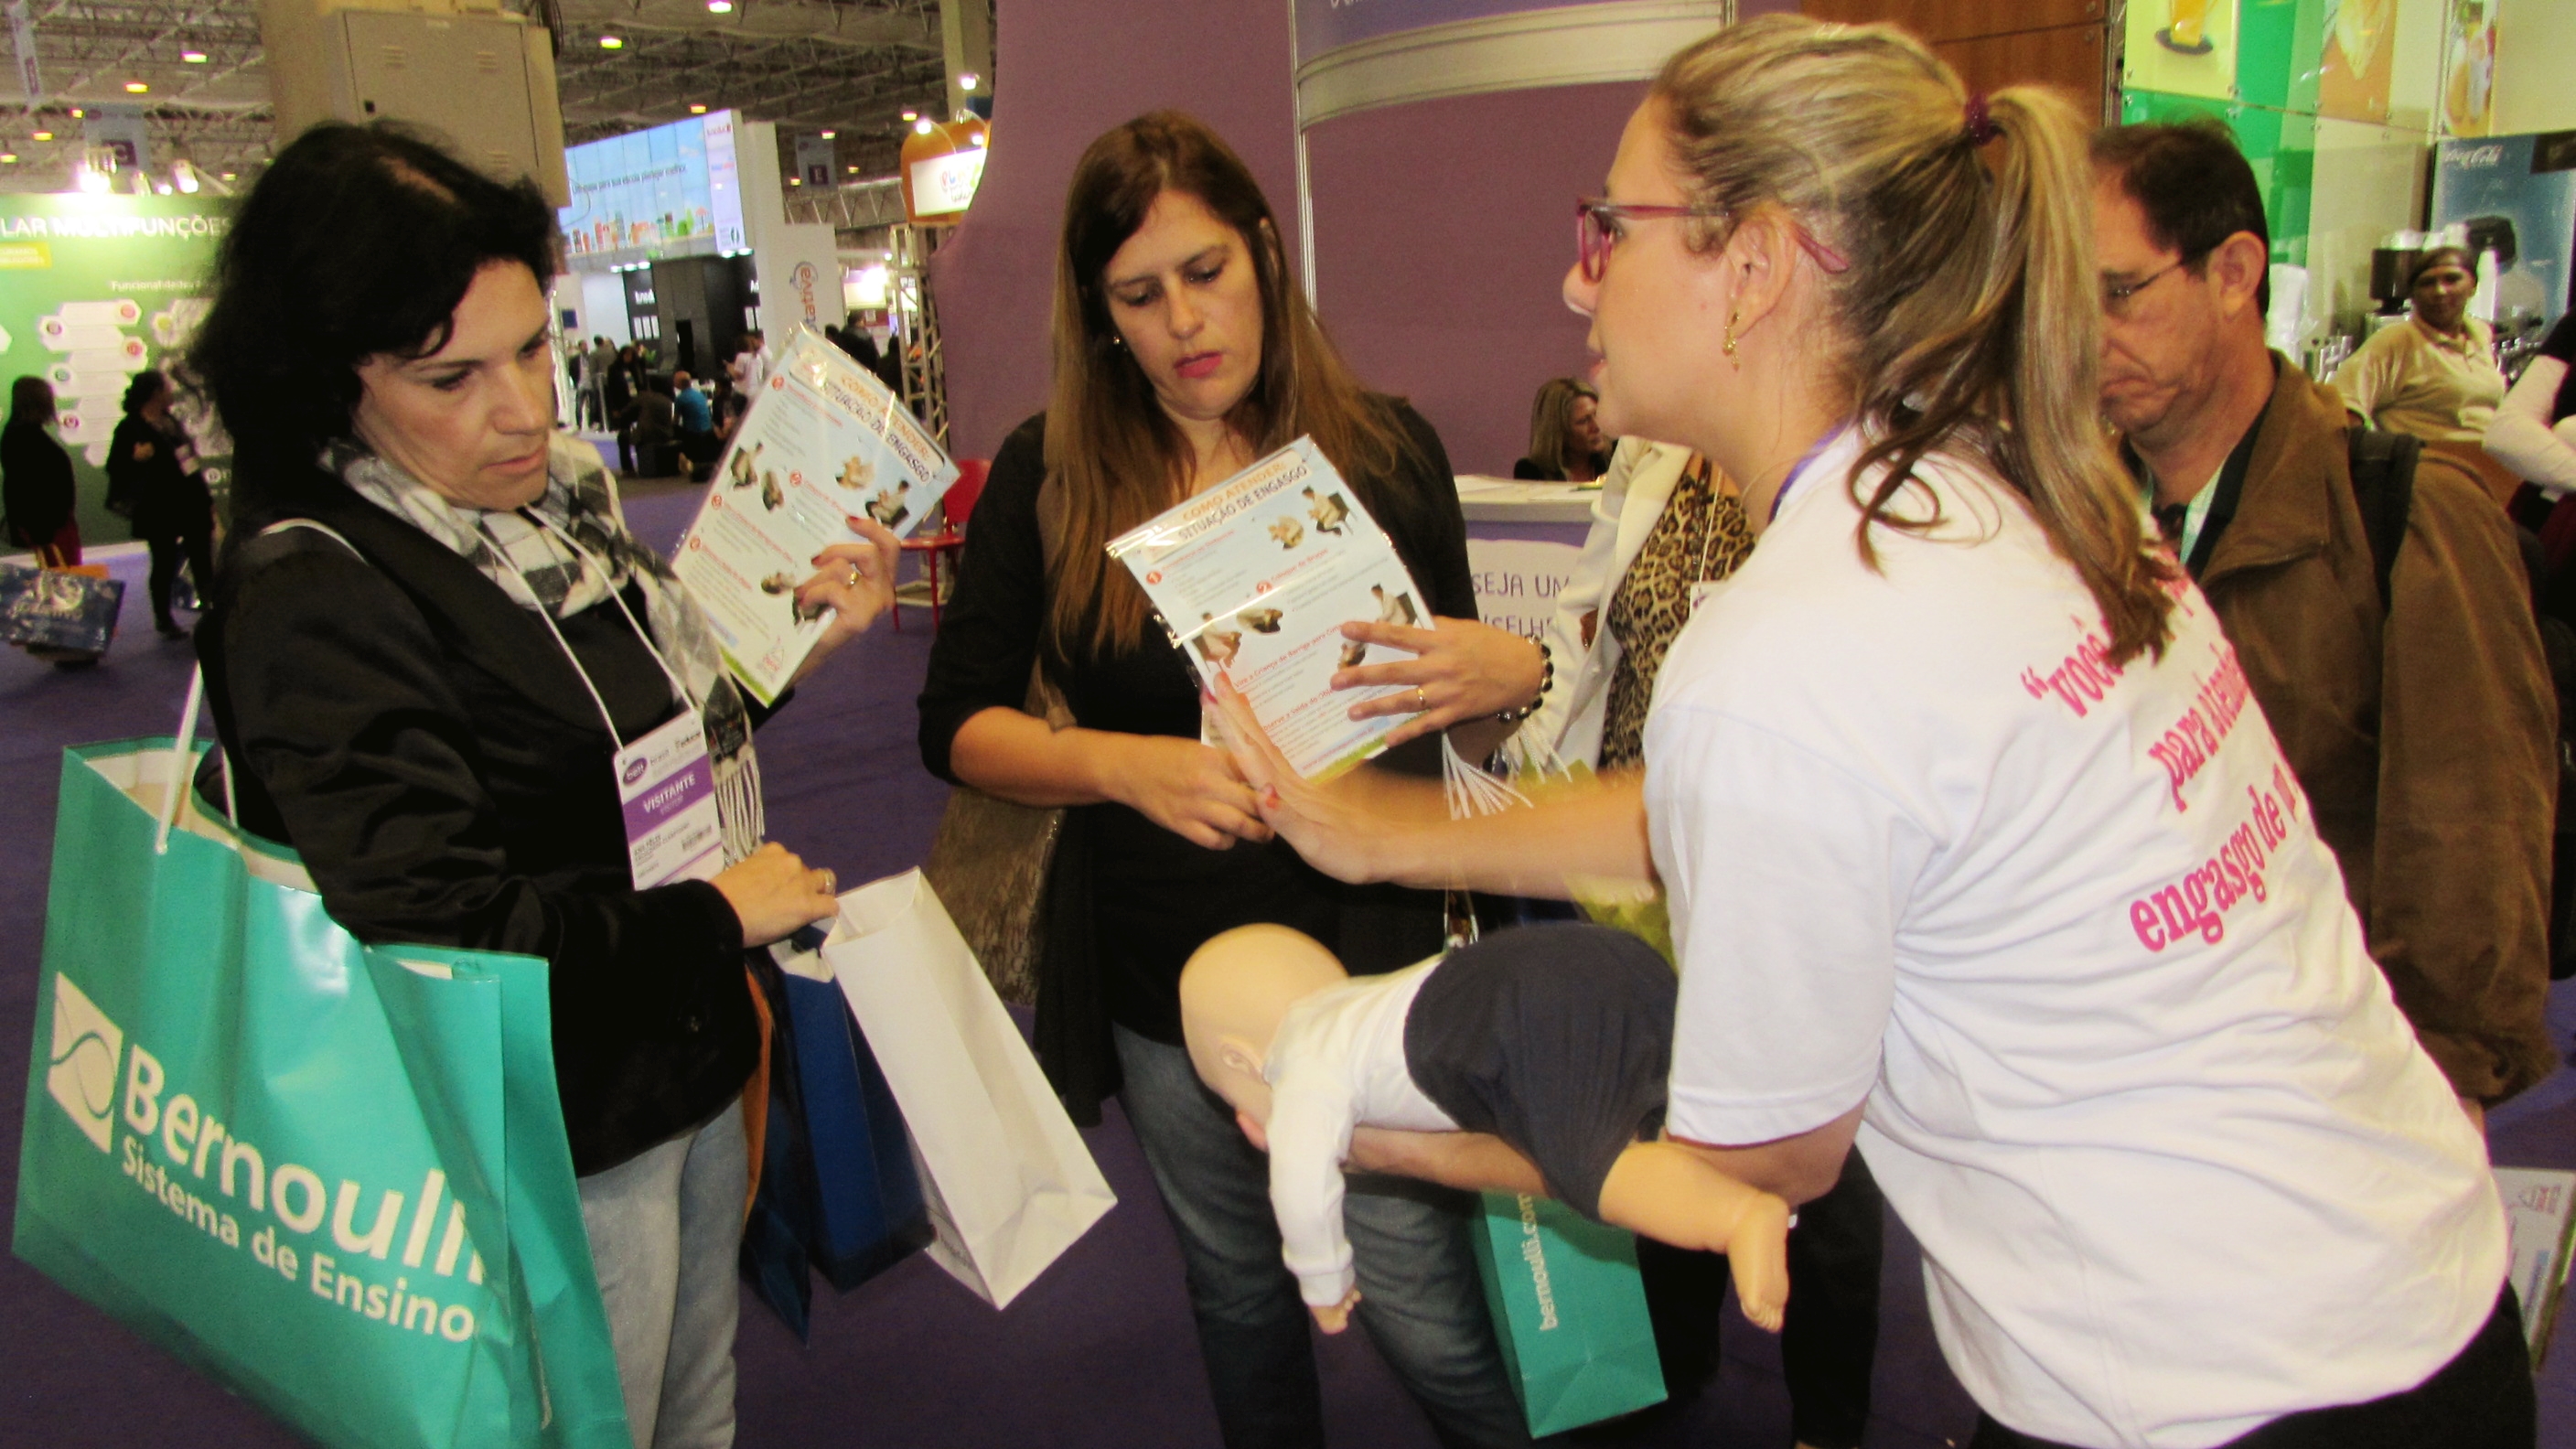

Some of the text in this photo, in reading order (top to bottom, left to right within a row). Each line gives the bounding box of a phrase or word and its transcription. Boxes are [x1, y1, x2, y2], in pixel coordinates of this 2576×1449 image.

[1177, 464, 1308, 541] SITUAÇÃO DE ENGASGO
[1182, 495, 1223, 521] COMO
[1471, 572, 1524, 597] SEJA
[642, 771, 696, 814] VISITANTE
[2147, 706, 2219, 813] para
[2130, 821, 2267, 953] engasgo
[2248, 783, 2286, 853] de
[124, 1045, 484, 1285] Bernoull
[122, 1135, 475, 1342] Sistema de Ensino
